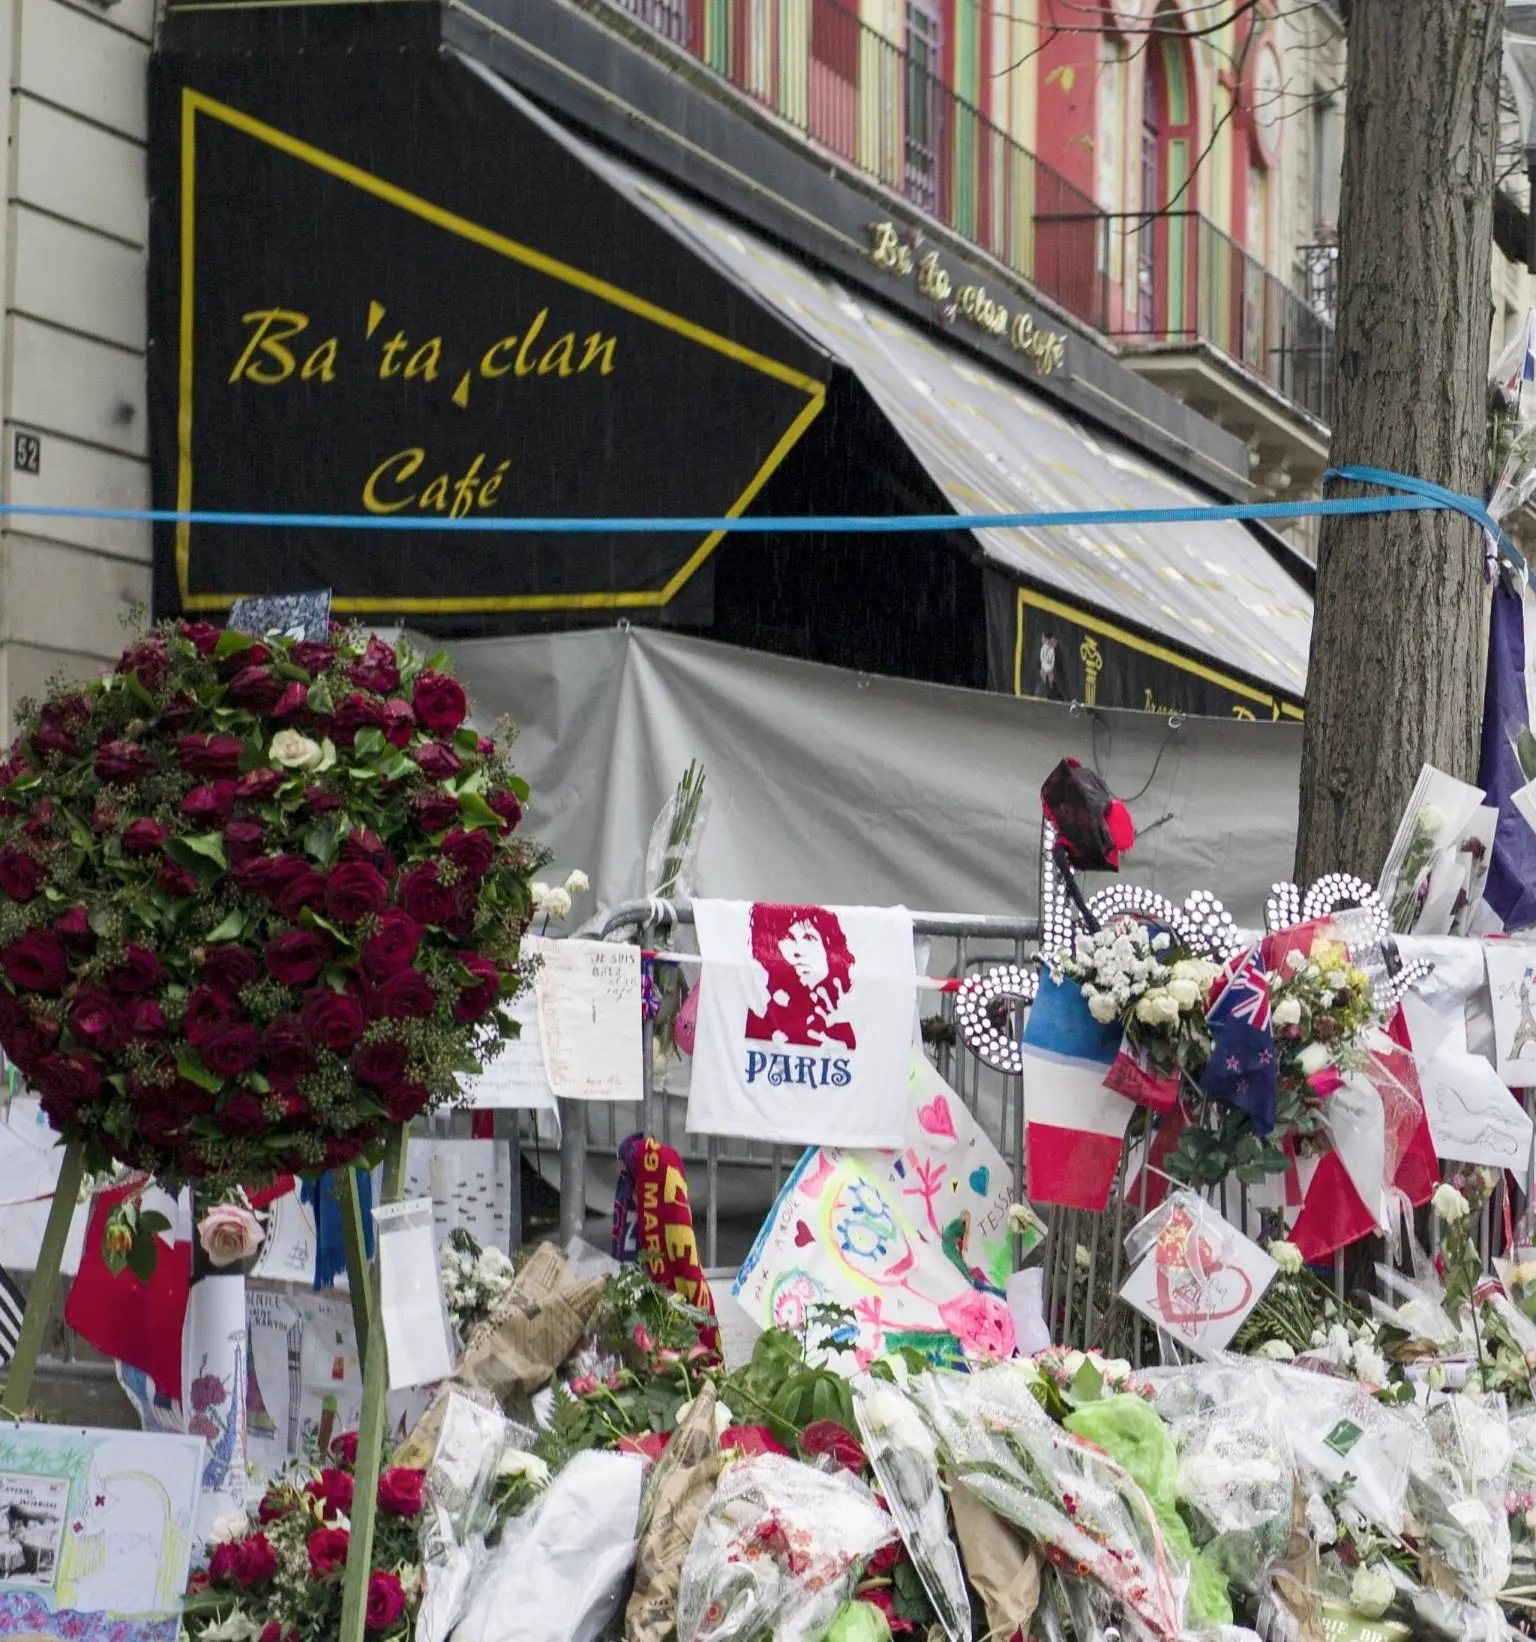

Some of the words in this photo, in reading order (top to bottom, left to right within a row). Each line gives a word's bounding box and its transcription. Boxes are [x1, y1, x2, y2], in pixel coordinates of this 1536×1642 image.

[15, 436, 39, 469] 52
[362, 447, 512, 521] Café
[744, 1050, 852, 1090] PARIS
[642, 1138, 661, 1174] 29
[642, 1182, 666, 1275] MARS
[976, 1186, 1016, 1238] TESSA
